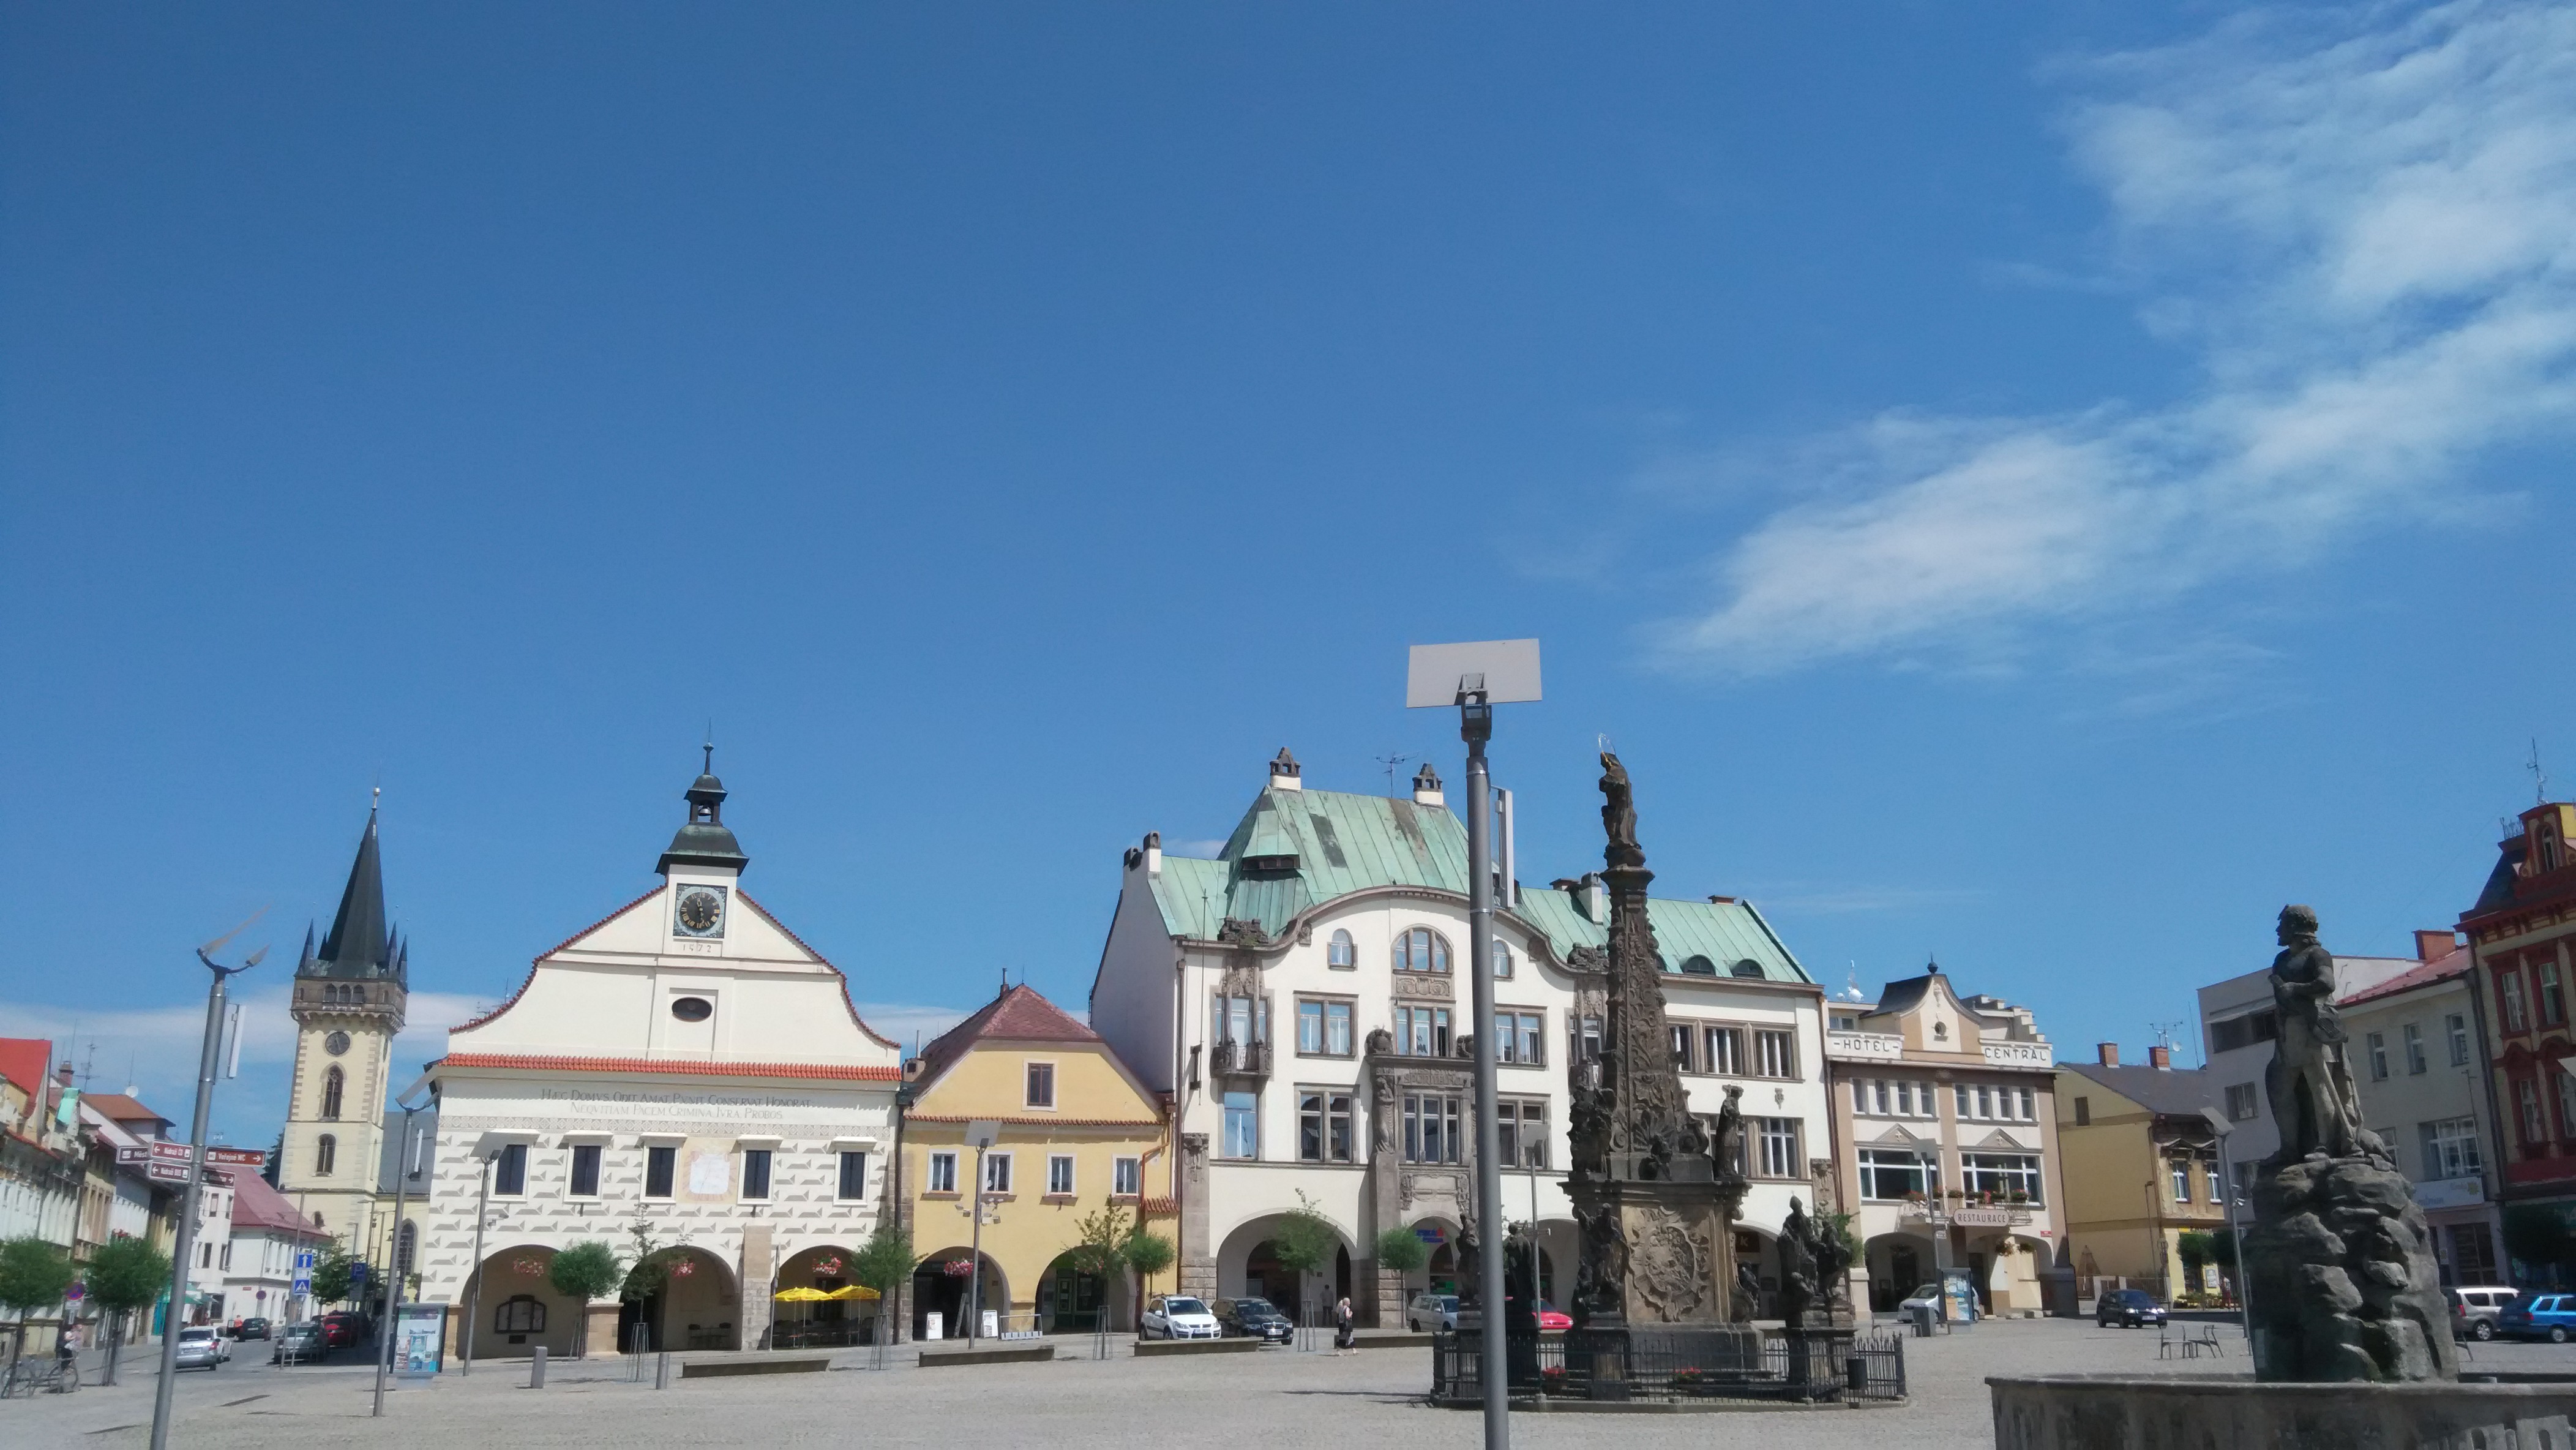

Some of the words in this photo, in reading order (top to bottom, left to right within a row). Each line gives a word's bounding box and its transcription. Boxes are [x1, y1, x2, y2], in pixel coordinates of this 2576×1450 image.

[683, 944, 711, 953] 1572
[1843, 1039, 1890, 1052] HOTEL
[1985, 1047, 2046, 1061] CENTRAL
[571, 1089, 610, 1102] DOMVS
[613, 1091, 637, 1102] ODIT
[640, 1093, 670, 1103] AMAT
[673, 1093, 704, 1104] PVNIT
[708, 1094, 762, 1106] CONSERVAT
[570, 1102, 629, 1114] NEQVITIAM
[1958, 1212, 2006, 1223] RESTAURACE
